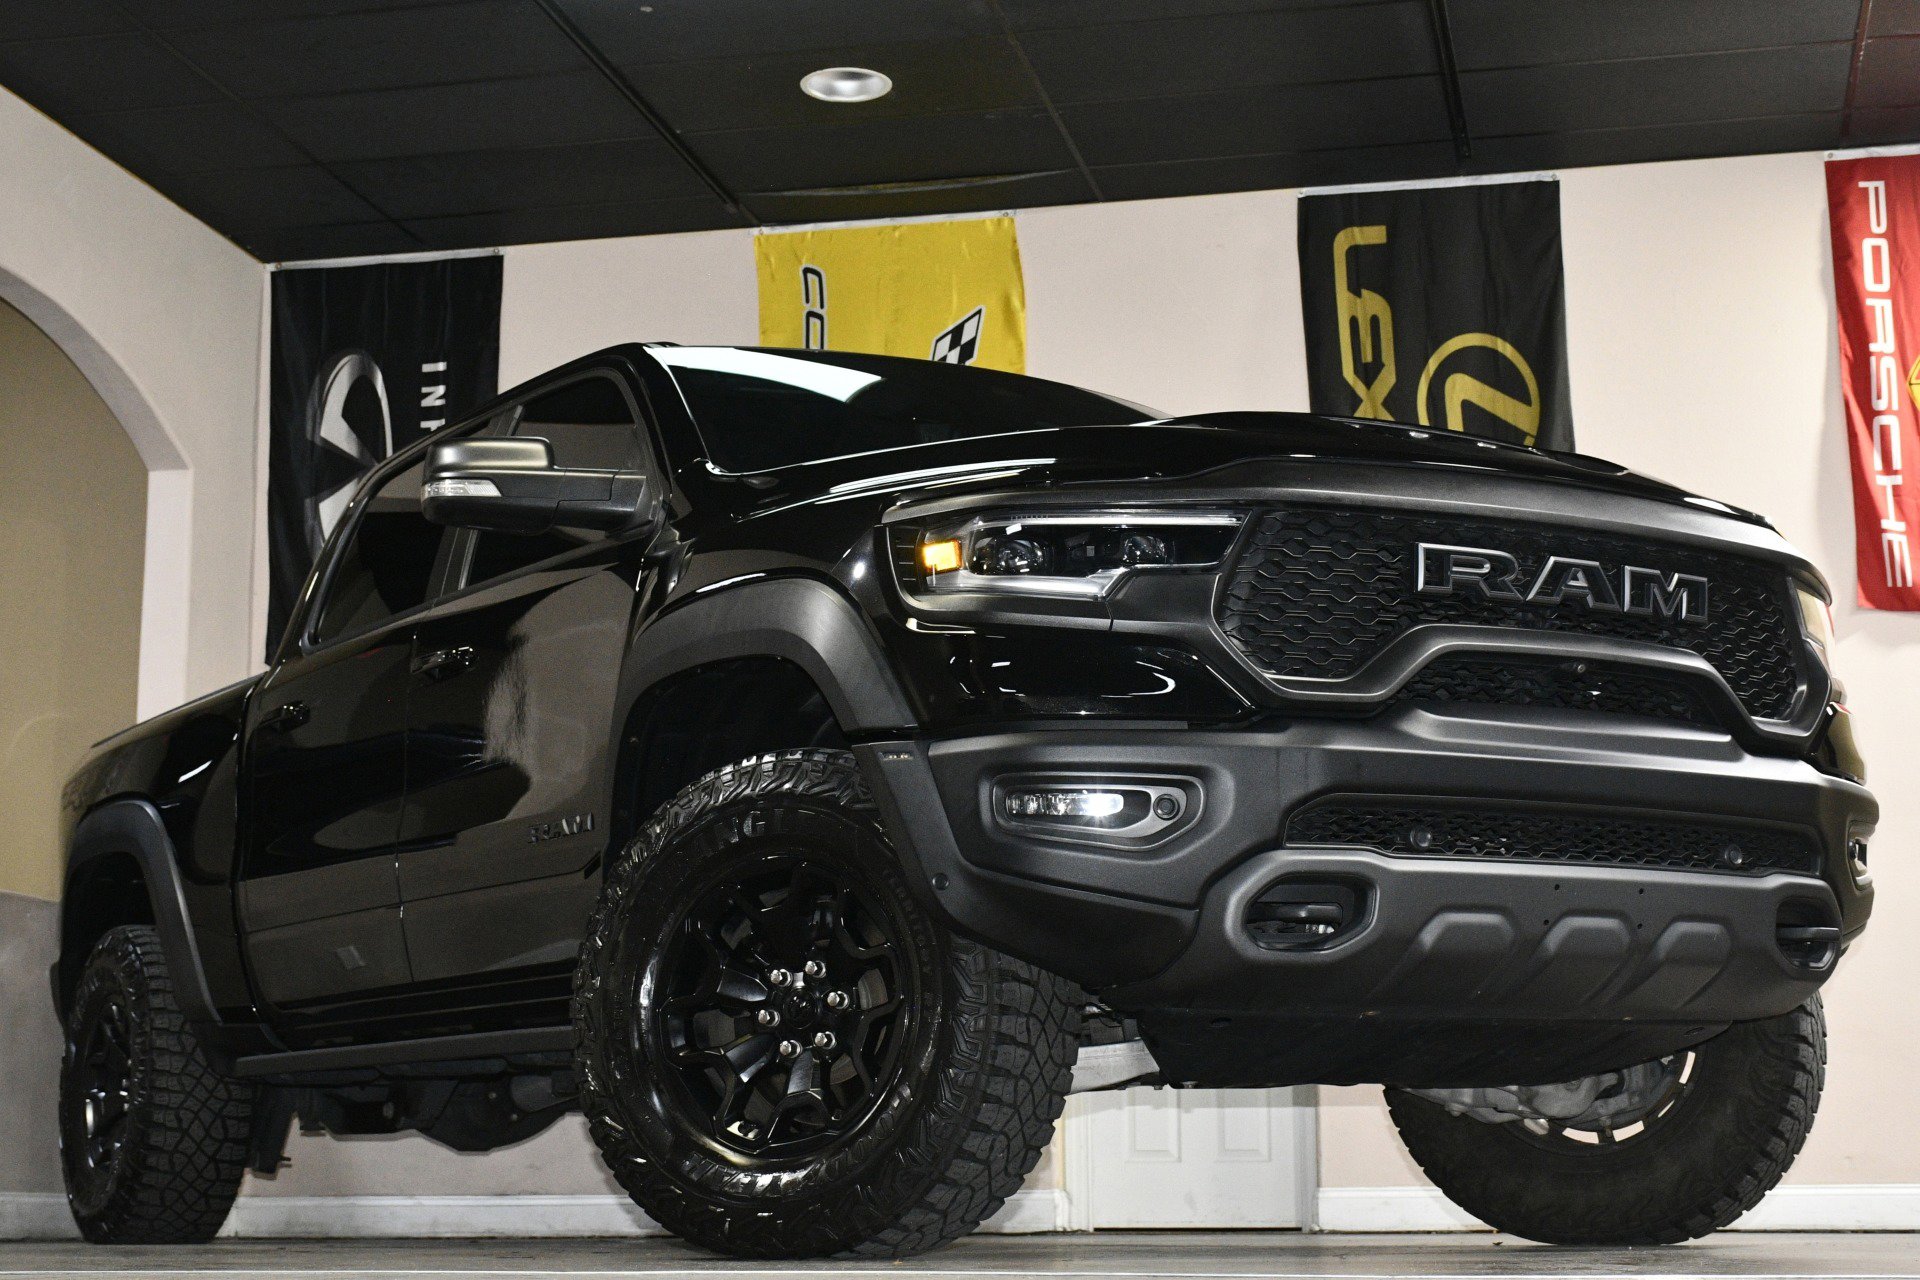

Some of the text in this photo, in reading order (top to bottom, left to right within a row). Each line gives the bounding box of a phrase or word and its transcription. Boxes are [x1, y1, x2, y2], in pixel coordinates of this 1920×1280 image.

[1858, 180, 1913, 588] PORSCHE
[1416, 541, 1708, 623] RAM
[528, 812, 594, 844] RAM
